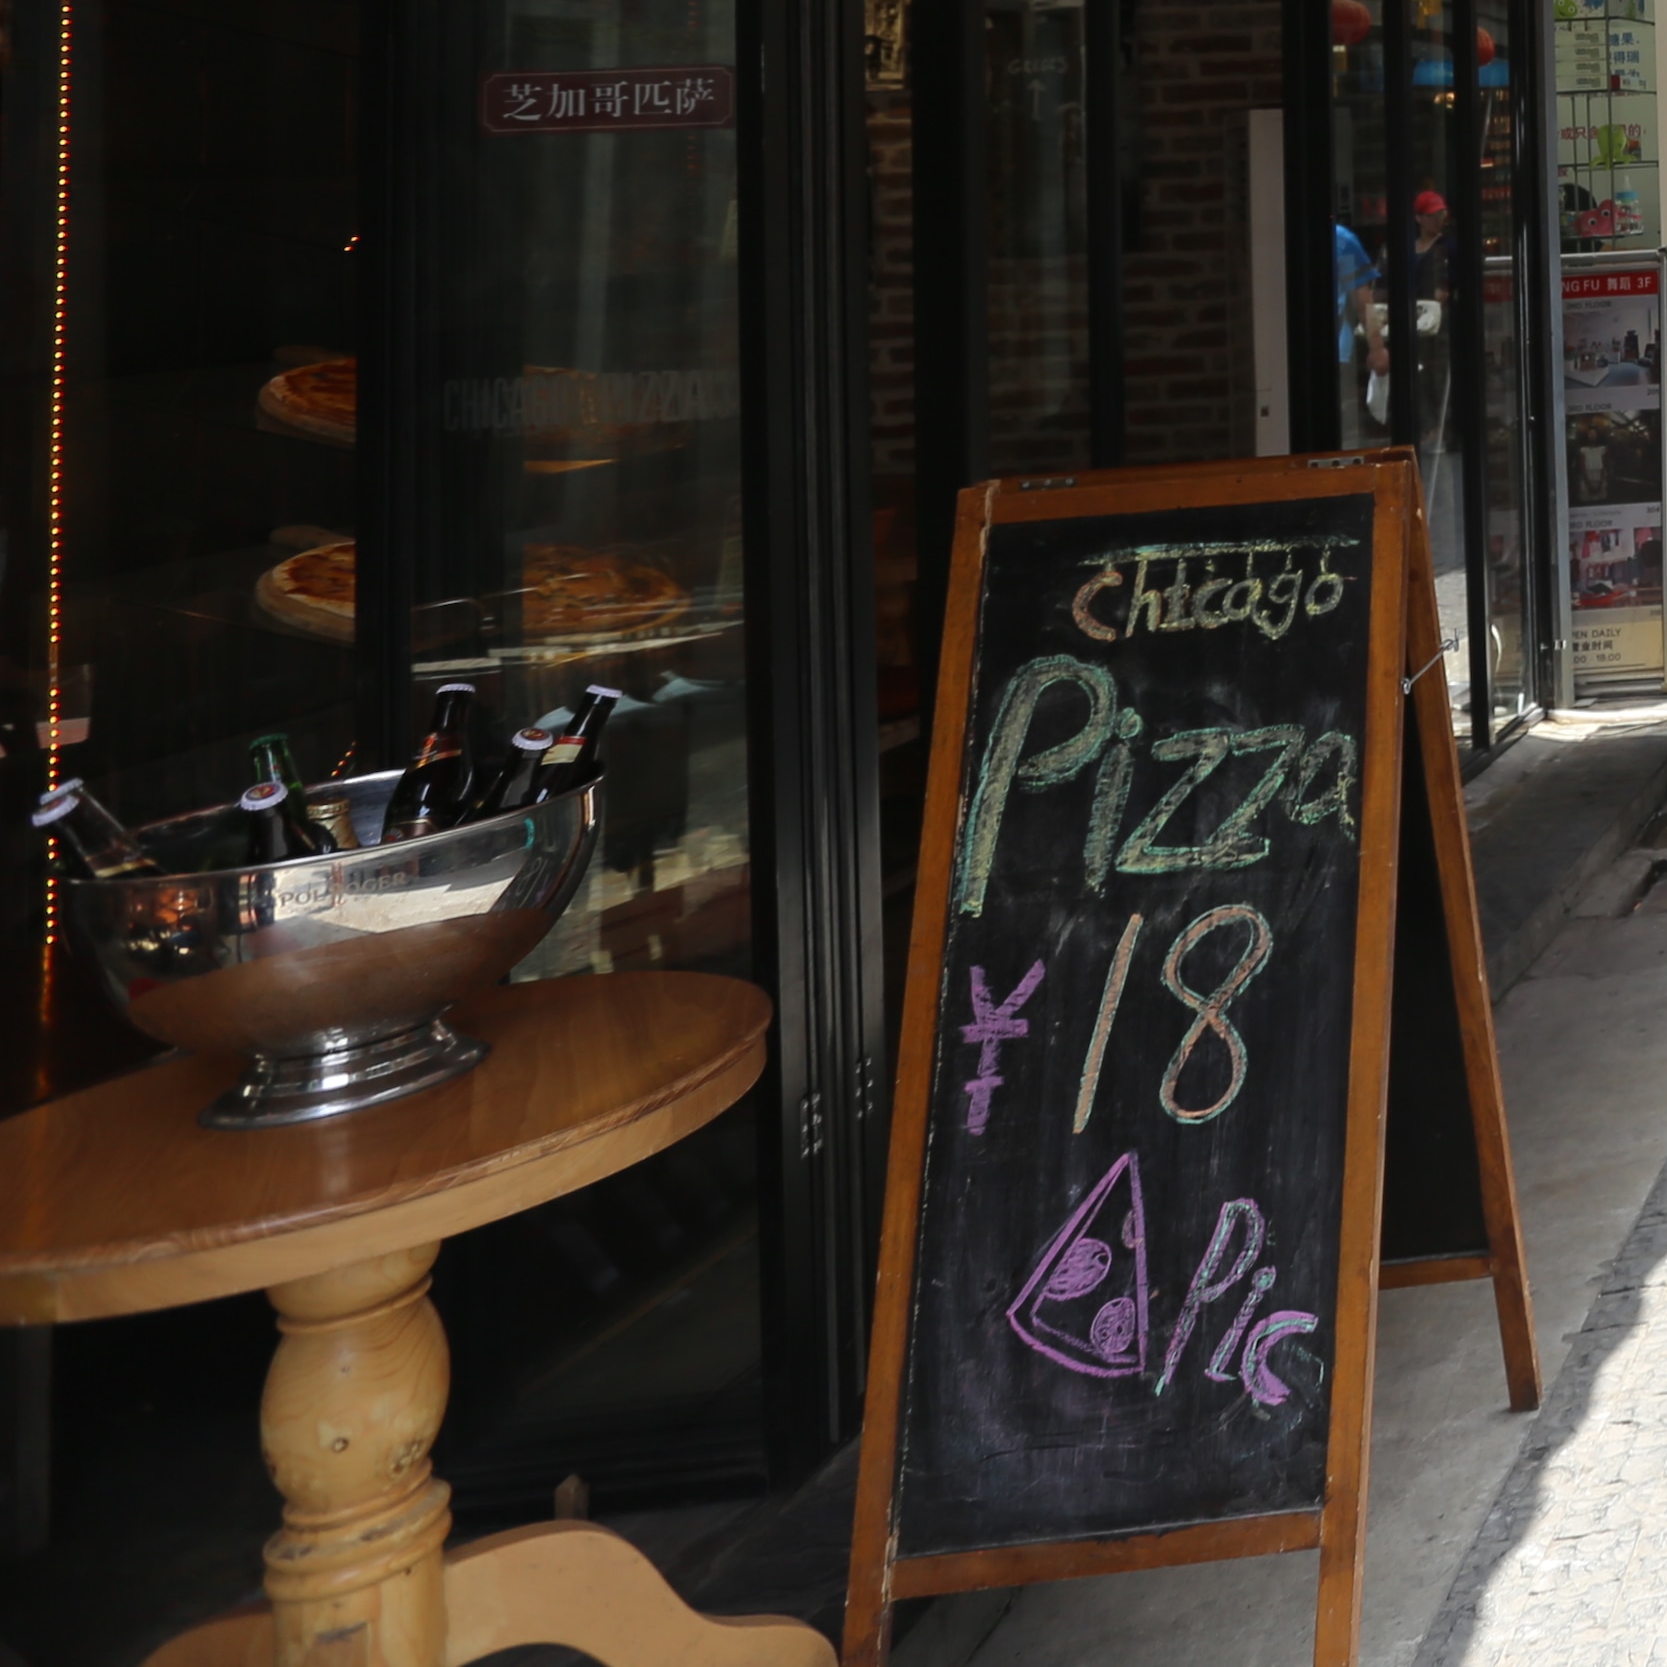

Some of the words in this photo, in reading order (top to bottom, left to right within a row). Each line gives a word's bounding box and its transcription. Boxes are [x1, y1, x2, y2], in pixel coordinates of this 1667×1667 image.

[502, 77, 716, 122] 芝加哥匹萨
[1562, 279, 1581, 293] NG
[1583, 278, 1601, 291] FU
[1637, 276, 1653, 289] 3F
[1591, 628, 1622, 638] DAILY
[958, 653, 1358, 918] Pizza
